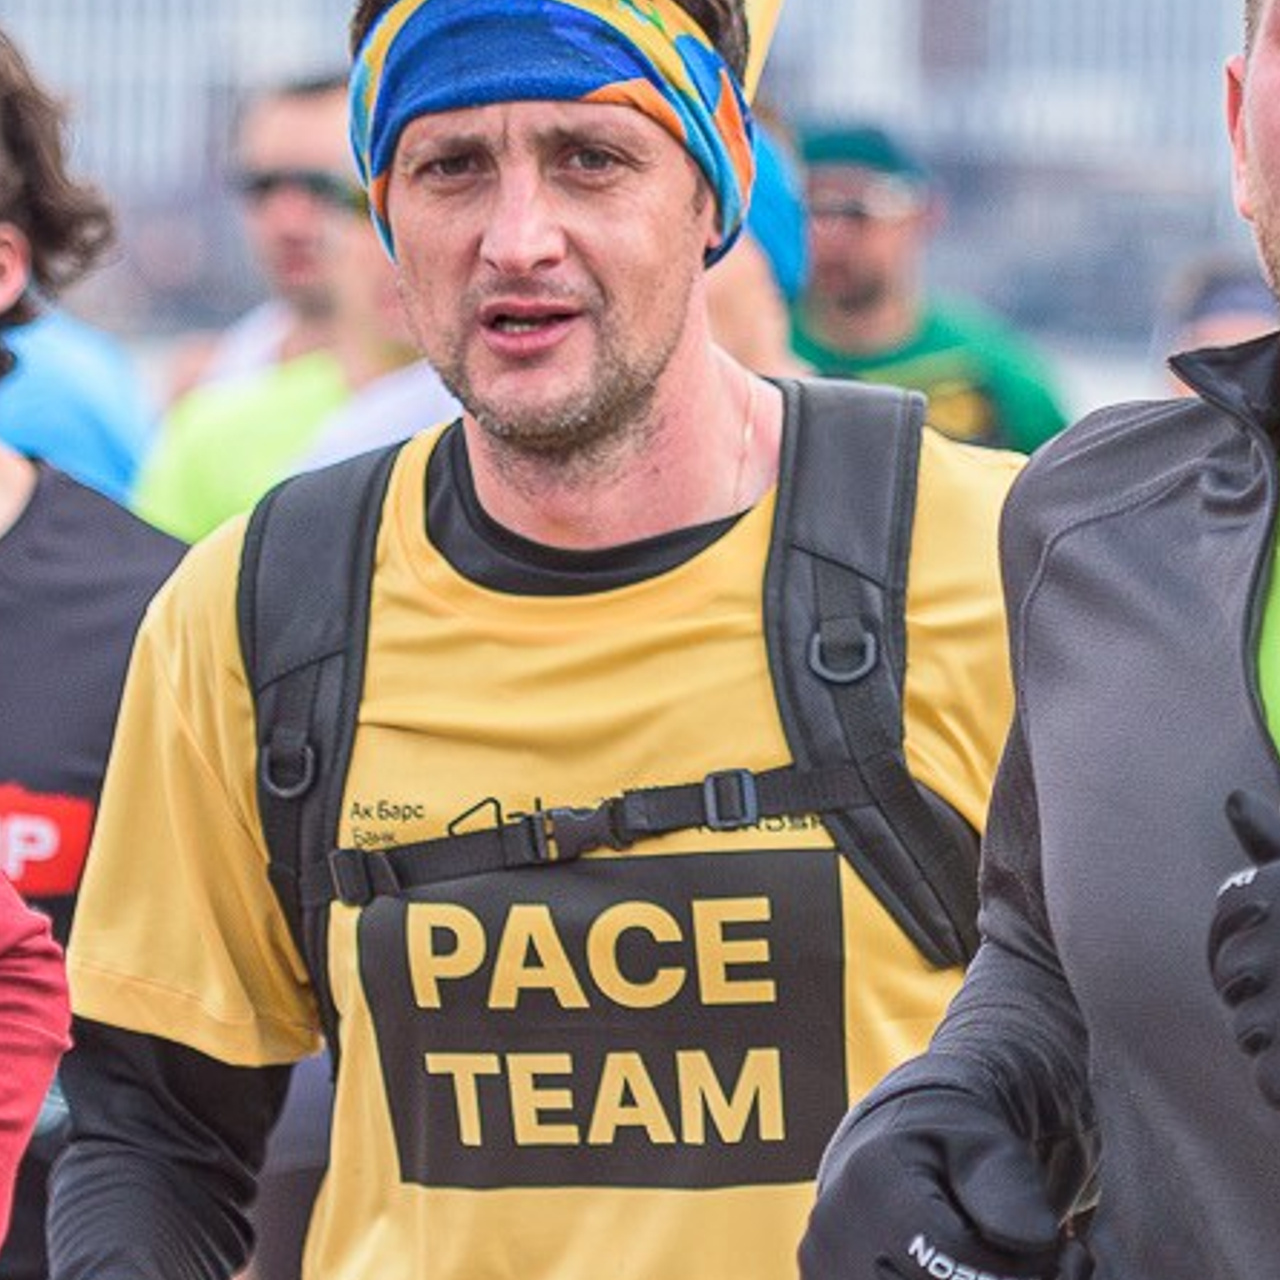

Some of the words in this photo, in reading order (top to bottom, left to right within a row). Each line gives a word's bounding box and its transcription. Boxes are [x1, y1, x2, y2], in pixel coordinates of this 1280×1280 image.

[350, 801, 373, 820] Ак
[376, 798, 425, 822] Барс
[406, 896, 777, 1010] PACE
[425, 1047, 786, 1147] TEAM
